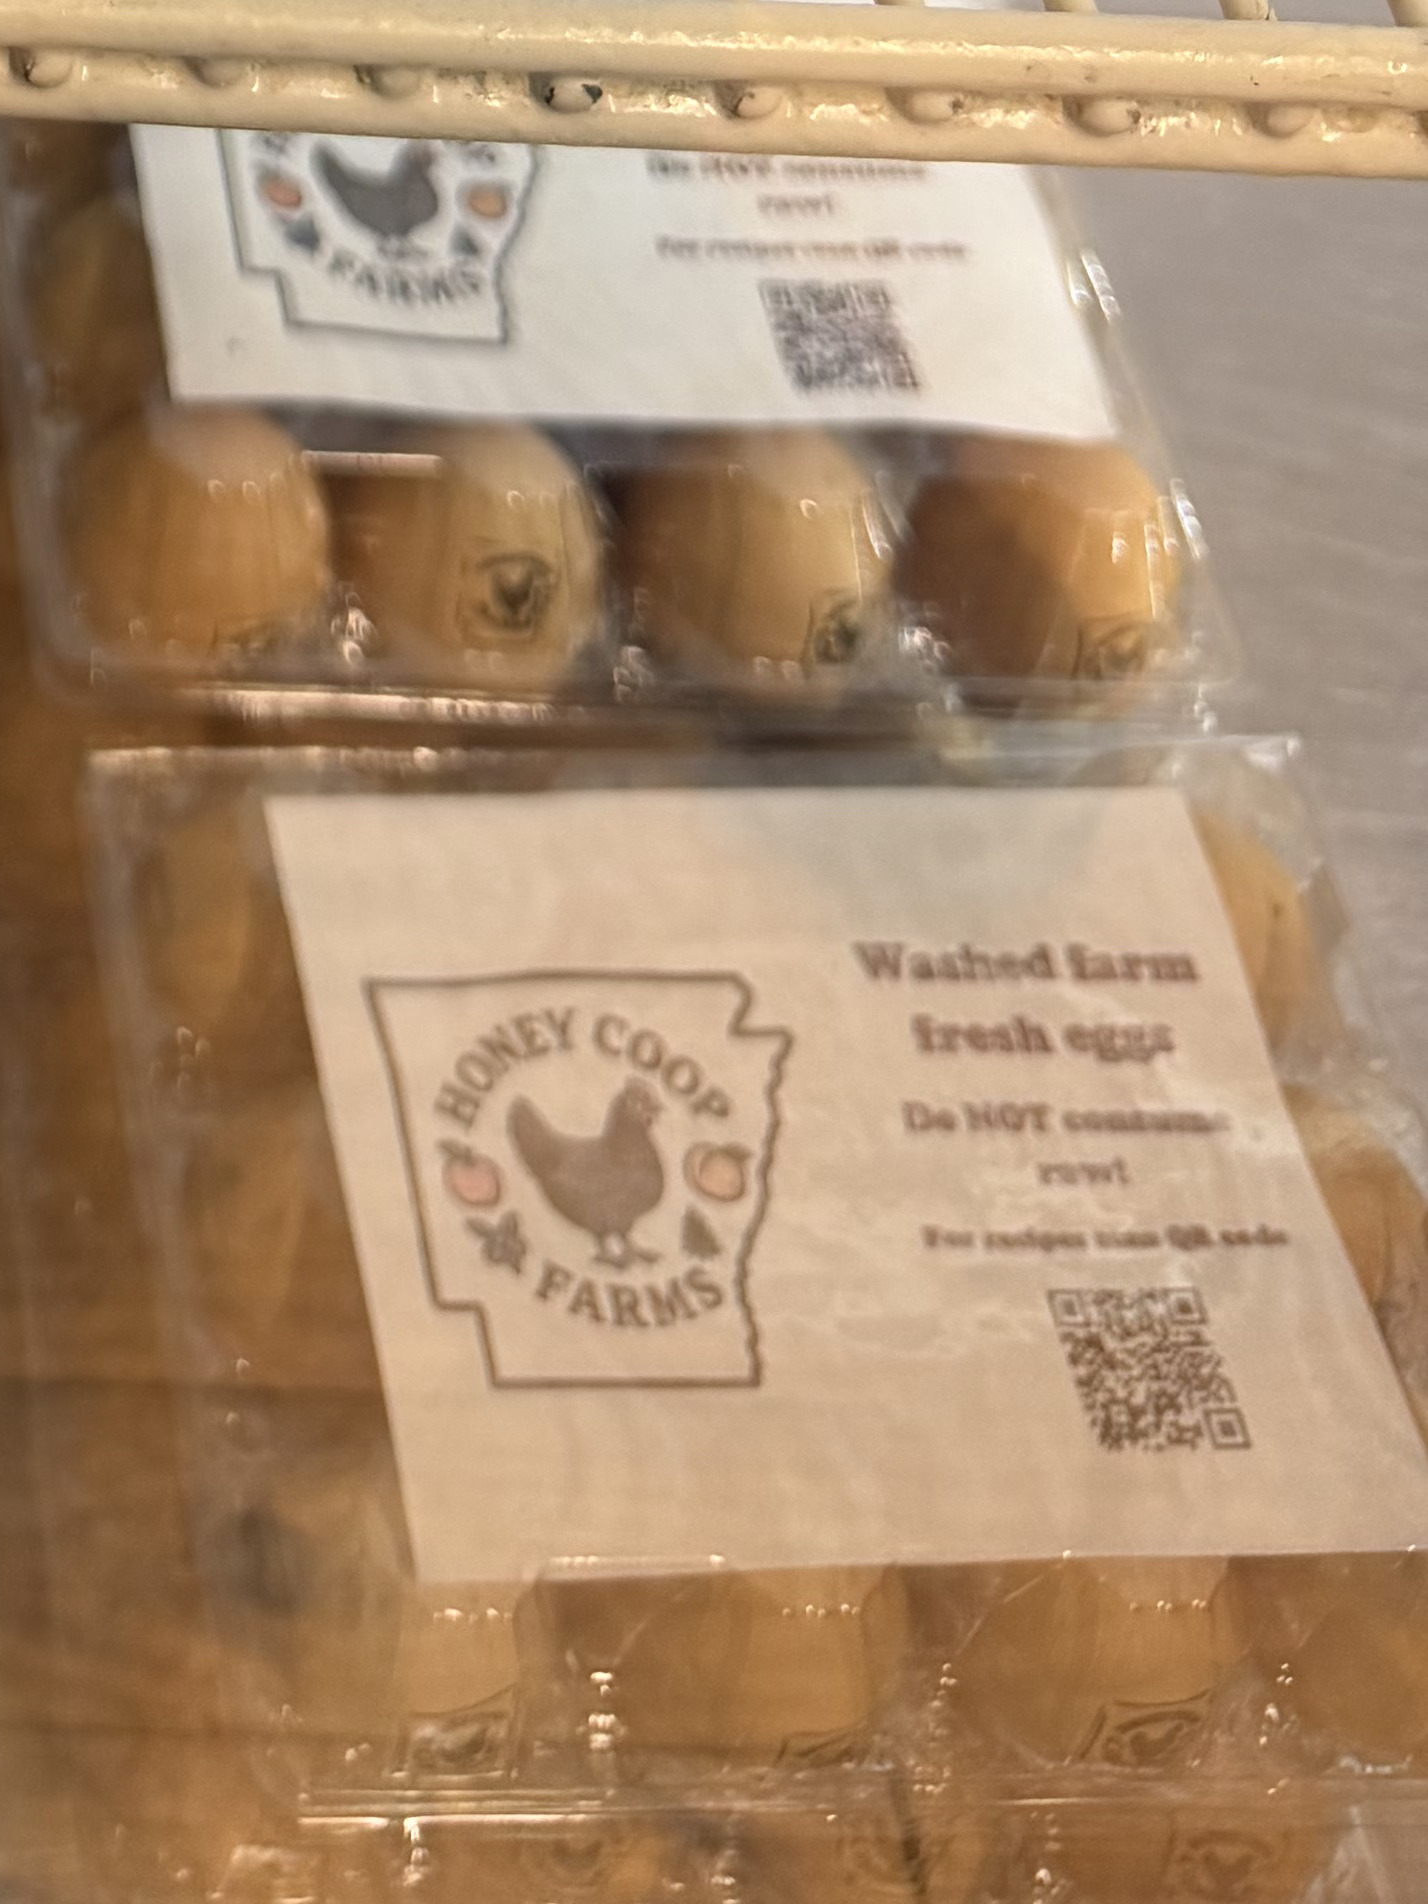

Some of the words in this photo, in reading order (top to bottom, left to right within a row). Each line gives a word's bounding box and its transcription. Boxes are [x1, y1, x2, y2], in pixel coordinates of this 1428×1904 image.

[855, 940, 1058, 985] Washed
[1067, 943, 1199, 983] farm
[912, 1017, 1053, 1055] fresh
[1064, 1018, 1174, 1065] eggs
[435, 1005, 579, 1129] HONEY
[592, 1012, 730, 1120] COOP
[901, 1102, 956, 1135] Do
[966, 1102, 1052, 1135] NOT
[536, 1259, 724, 1327] FARMS
